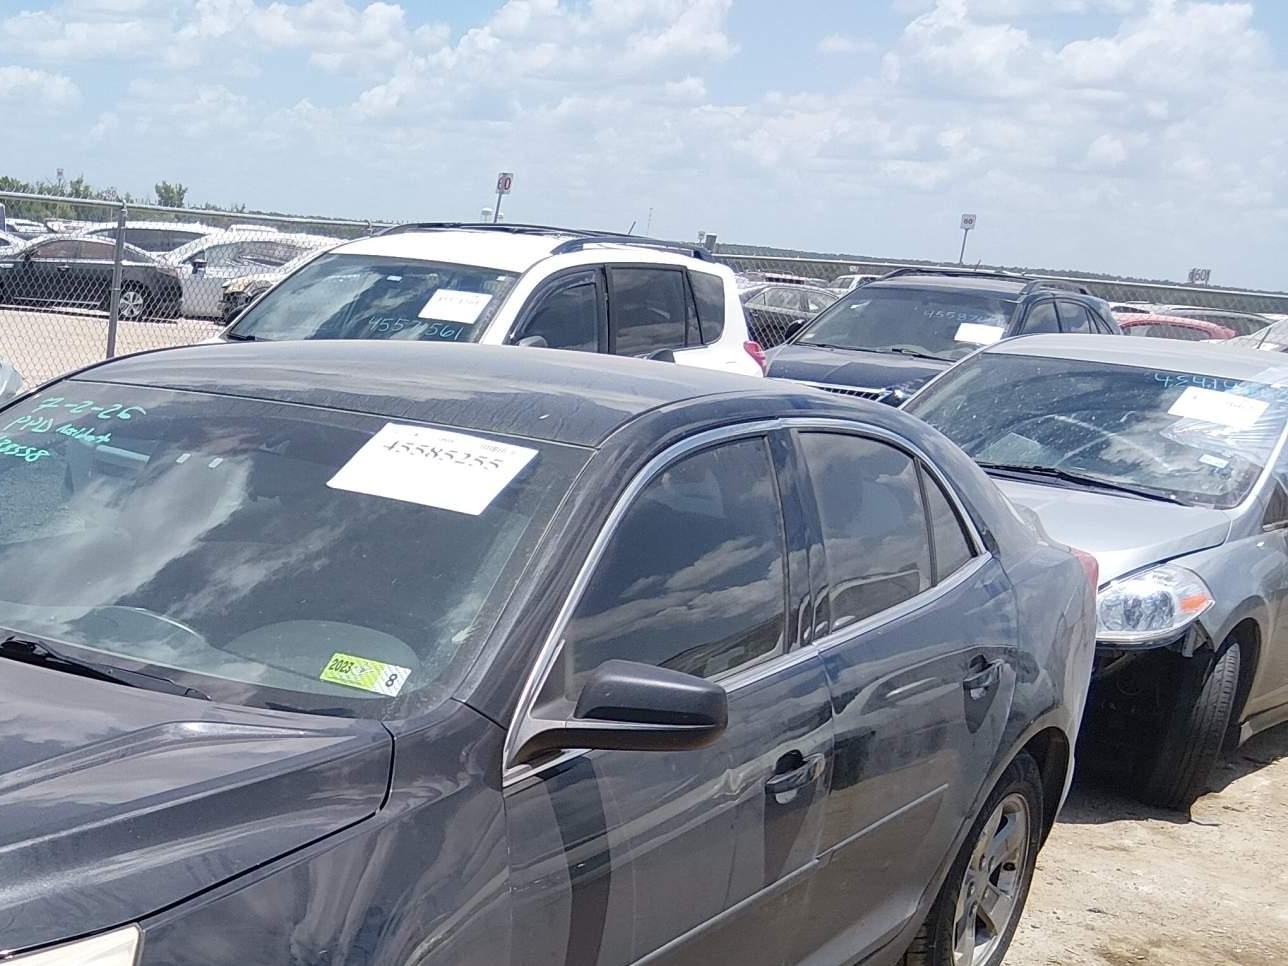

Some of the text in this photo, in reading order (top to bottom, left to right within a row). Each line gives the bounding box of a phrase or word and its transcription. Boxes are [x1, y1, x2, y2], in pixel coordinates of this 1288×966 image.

[382, 440, 505, 471] 45585255
[328, 658, 398, 688] 2023 8
